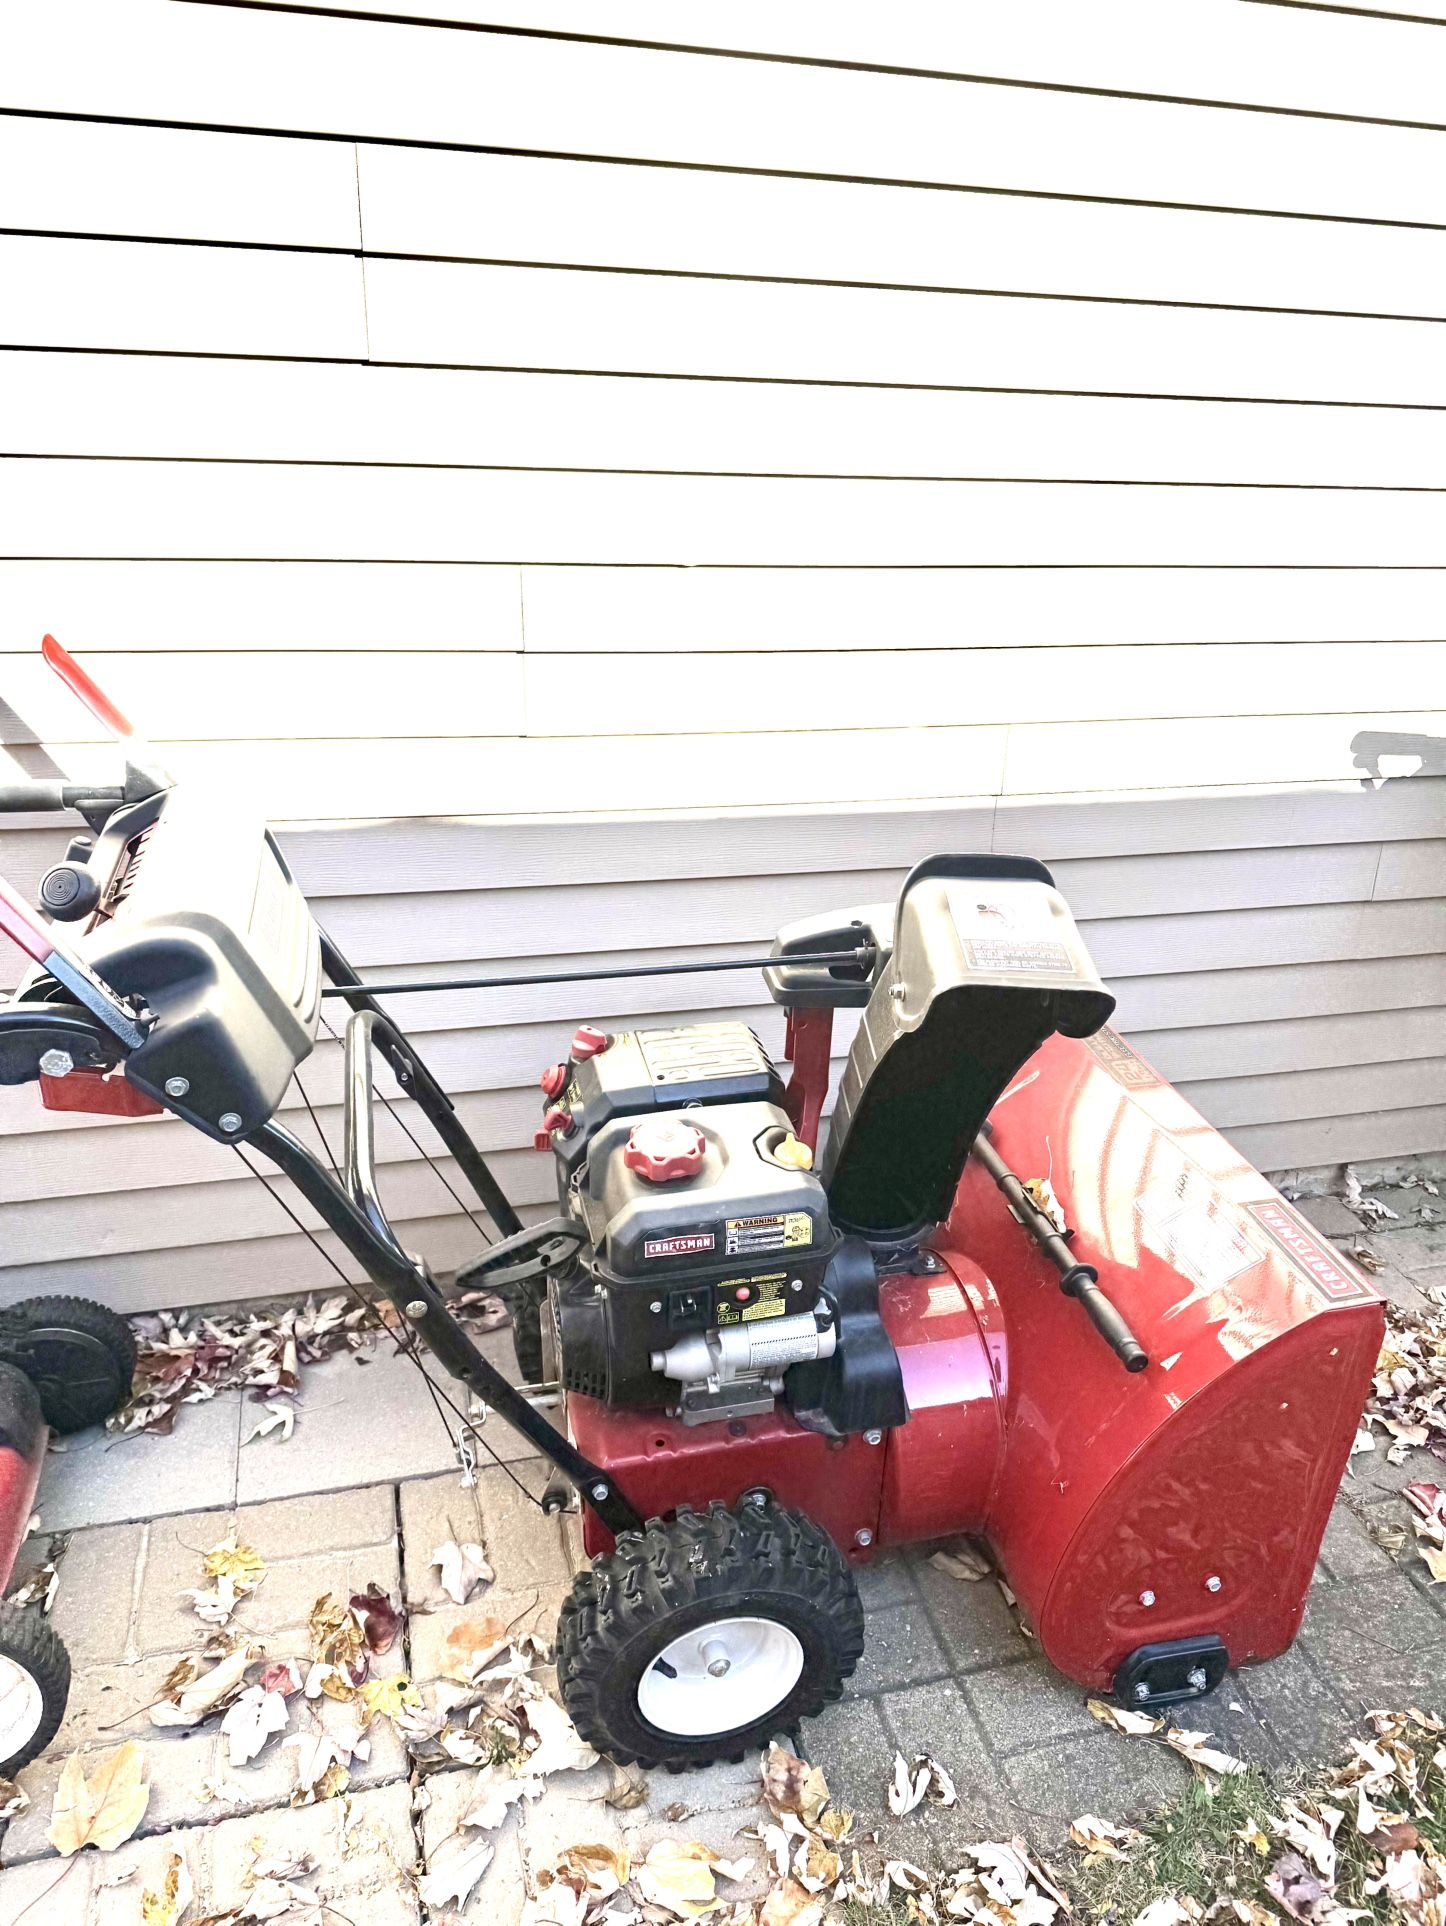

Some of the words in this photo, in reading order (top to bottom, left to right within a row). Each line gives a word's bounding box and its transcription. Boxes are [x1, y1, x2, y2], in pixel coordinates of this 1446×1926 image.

[742, 1216, 778, 1227] WARNING
[648, 1237, 711, 1254] CRAFTSMAN
[1260, 1208, 1349, 1290] CRAFTSMAN
